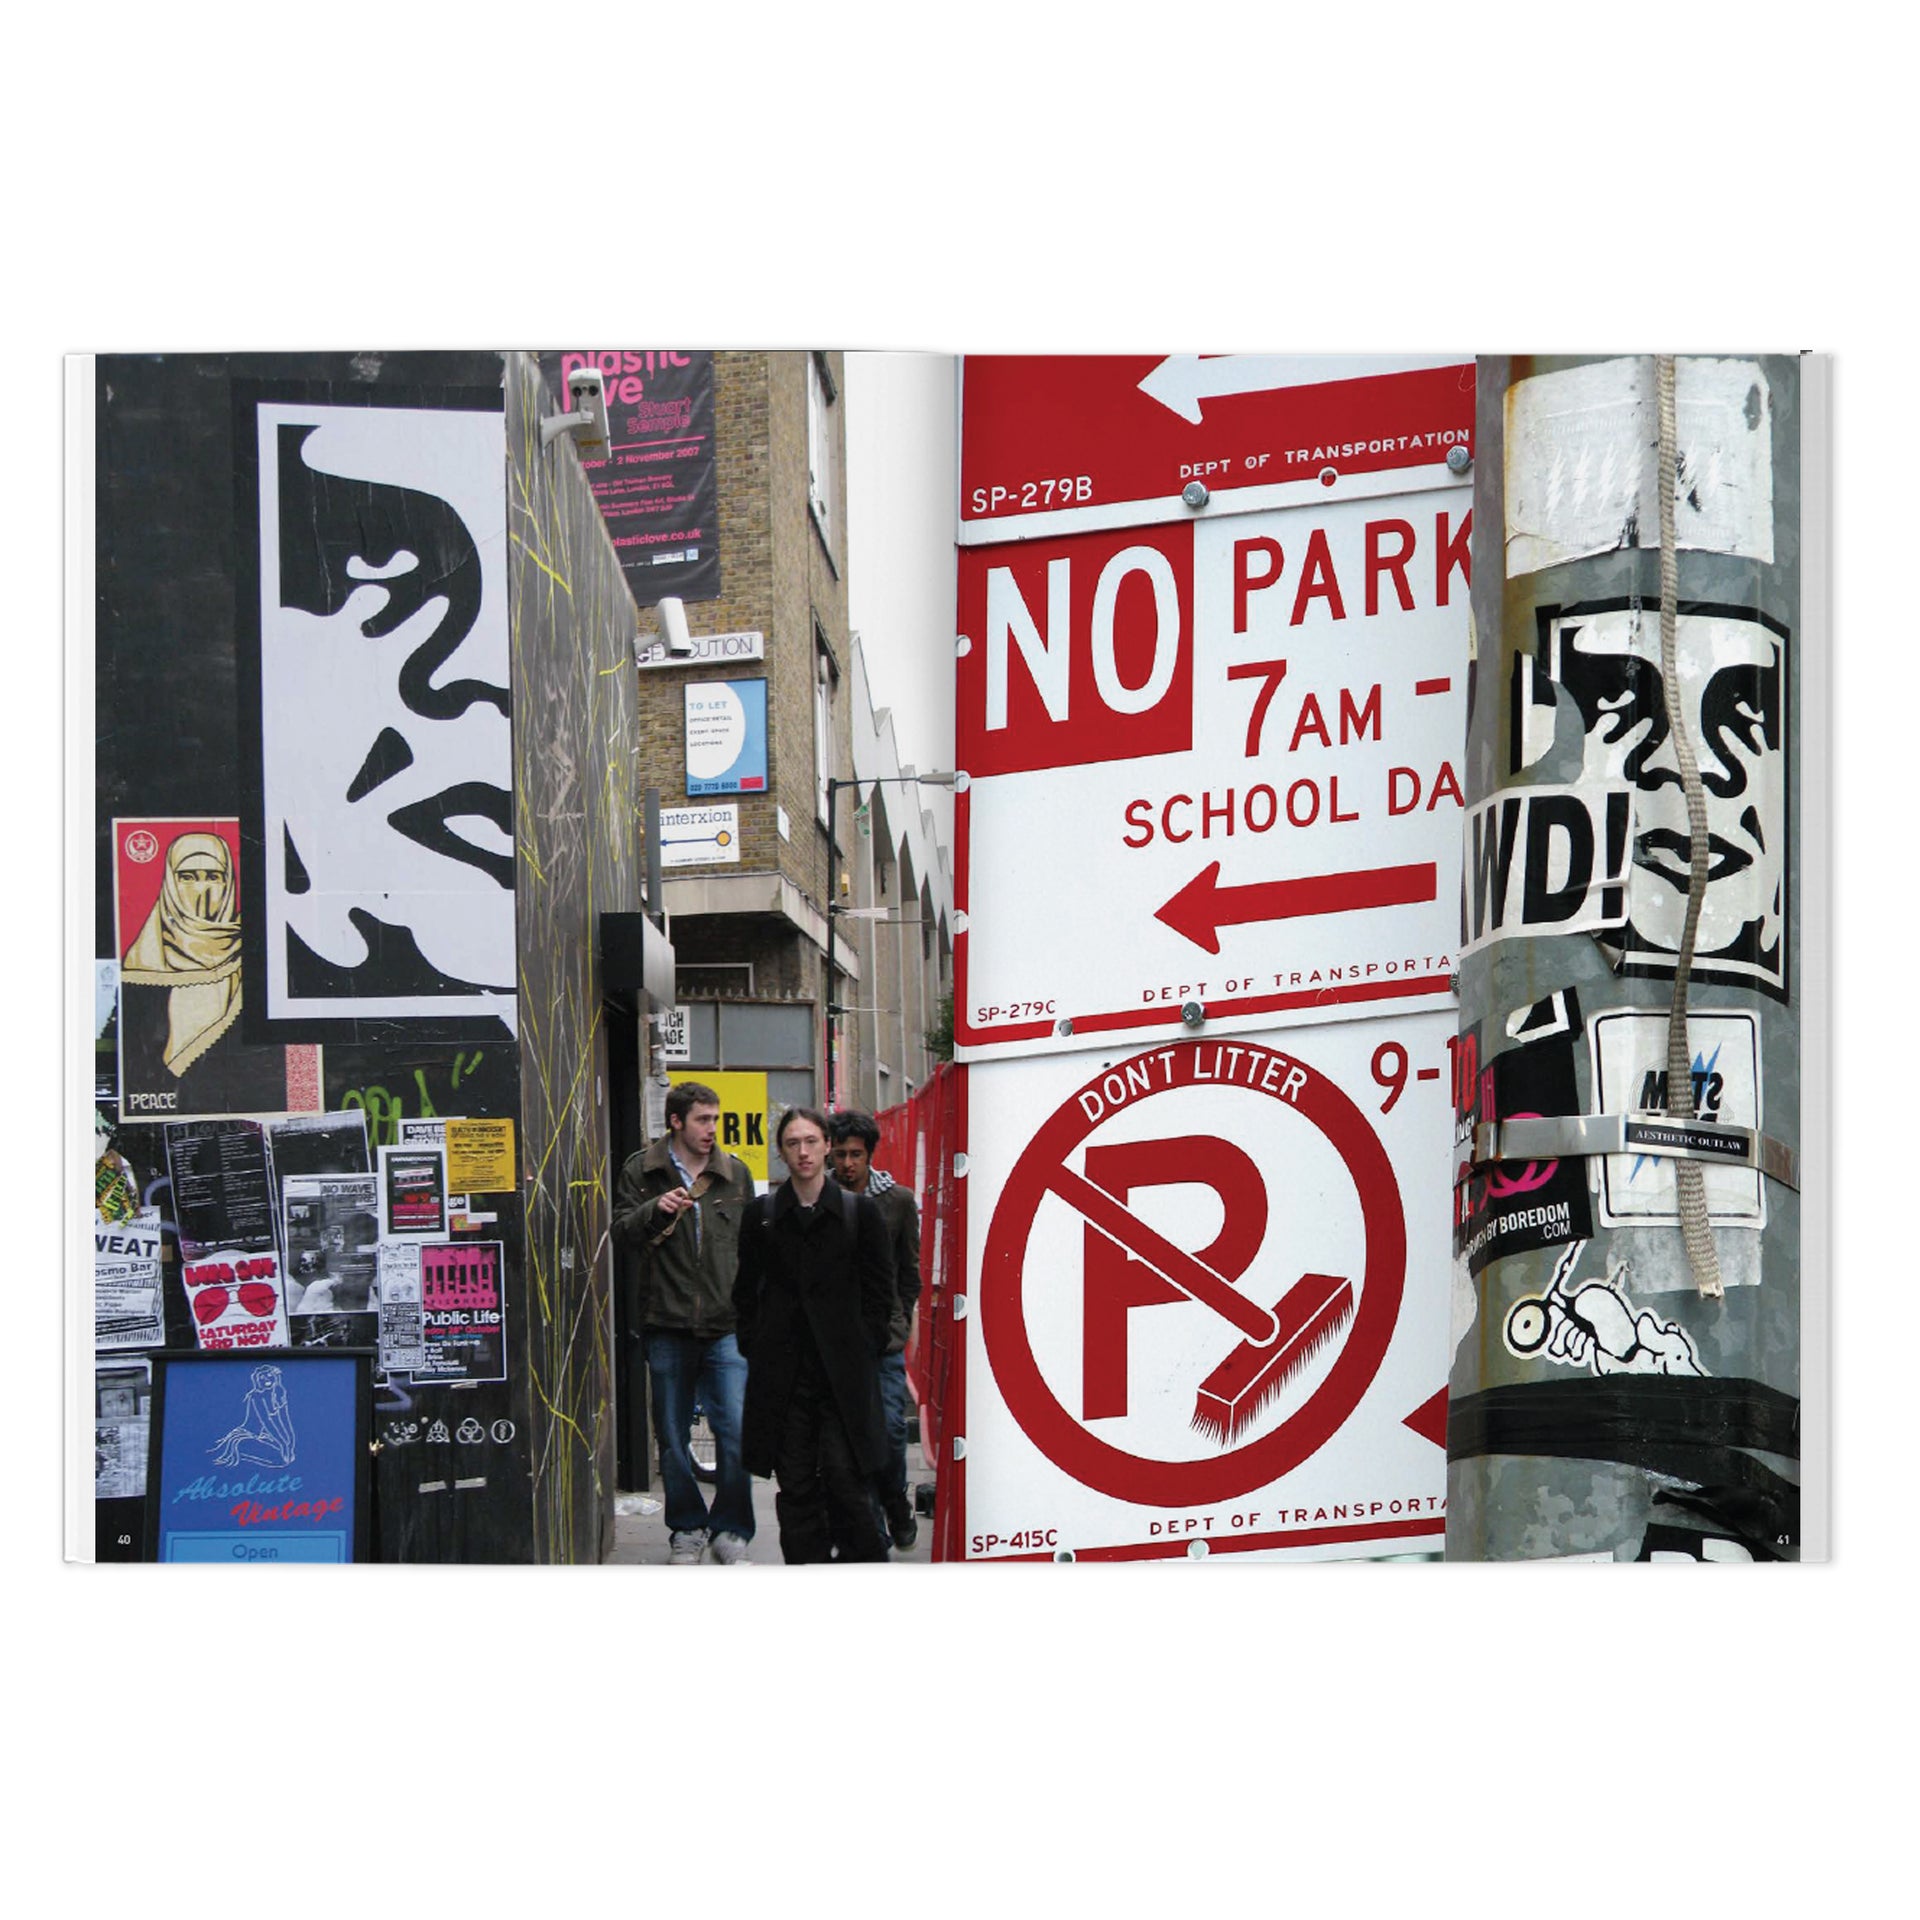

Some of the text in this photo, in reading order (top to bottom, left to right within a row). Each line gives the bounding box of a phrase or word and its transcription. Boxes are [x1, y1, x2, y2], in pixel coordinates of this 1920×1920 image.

[617, 456, 624, 465] 2
[626, 450, 675, 464] November
[676, 446, 700, 459] 2007
[1179, 429, 1470, 479] DEPT OF TRANSPORTATION
[972, 476, 1093, 513] SP-279B
[985, 508, 1473, 732] NO PARK
[689, 701, 728, 711] TO LET
[1123, 761, 1465, 849] SCHOOL DA
[1142, 955, 1452, 1003] DEPT OF TRANSPORTA
[977, 1000, 1056, 1023] SP-279C
[1077, 1046, 1309, 1123] DON'T LITTER
[130, 1094, 176, 1110] PEACE
[722, 1112, 764, 1146] RK
[1636, 1130, 1742, 1150] AESTHETIC OUTLAW
[341, 1183, 373, 1194] WAVE
[1487, 1218, 1498, 1241] BY
[1499, 1201, 1570, 1235] BOREDOM
[131, 1262, 152, 1273] Bar
[423, 1309, 500, 1325] Public Life
[199, 1320, 278, 1340] SATURDAY
[237, 1333, 271, 1347] NOV
[172, 1473, 303, 1504] Absolute
[230, 1497, 344, 1526] Vintage
[1150, 1517, 1213, 1537] DEPT
[1231, 1512, 1262, 1529] OF
[117, 1535, 131, 1545] 40
[972, 1529, 1058, 1554] SP-415C
[1776, 1533, 1790, 1545] 41
[232, 1544, 278, 1561] Open
